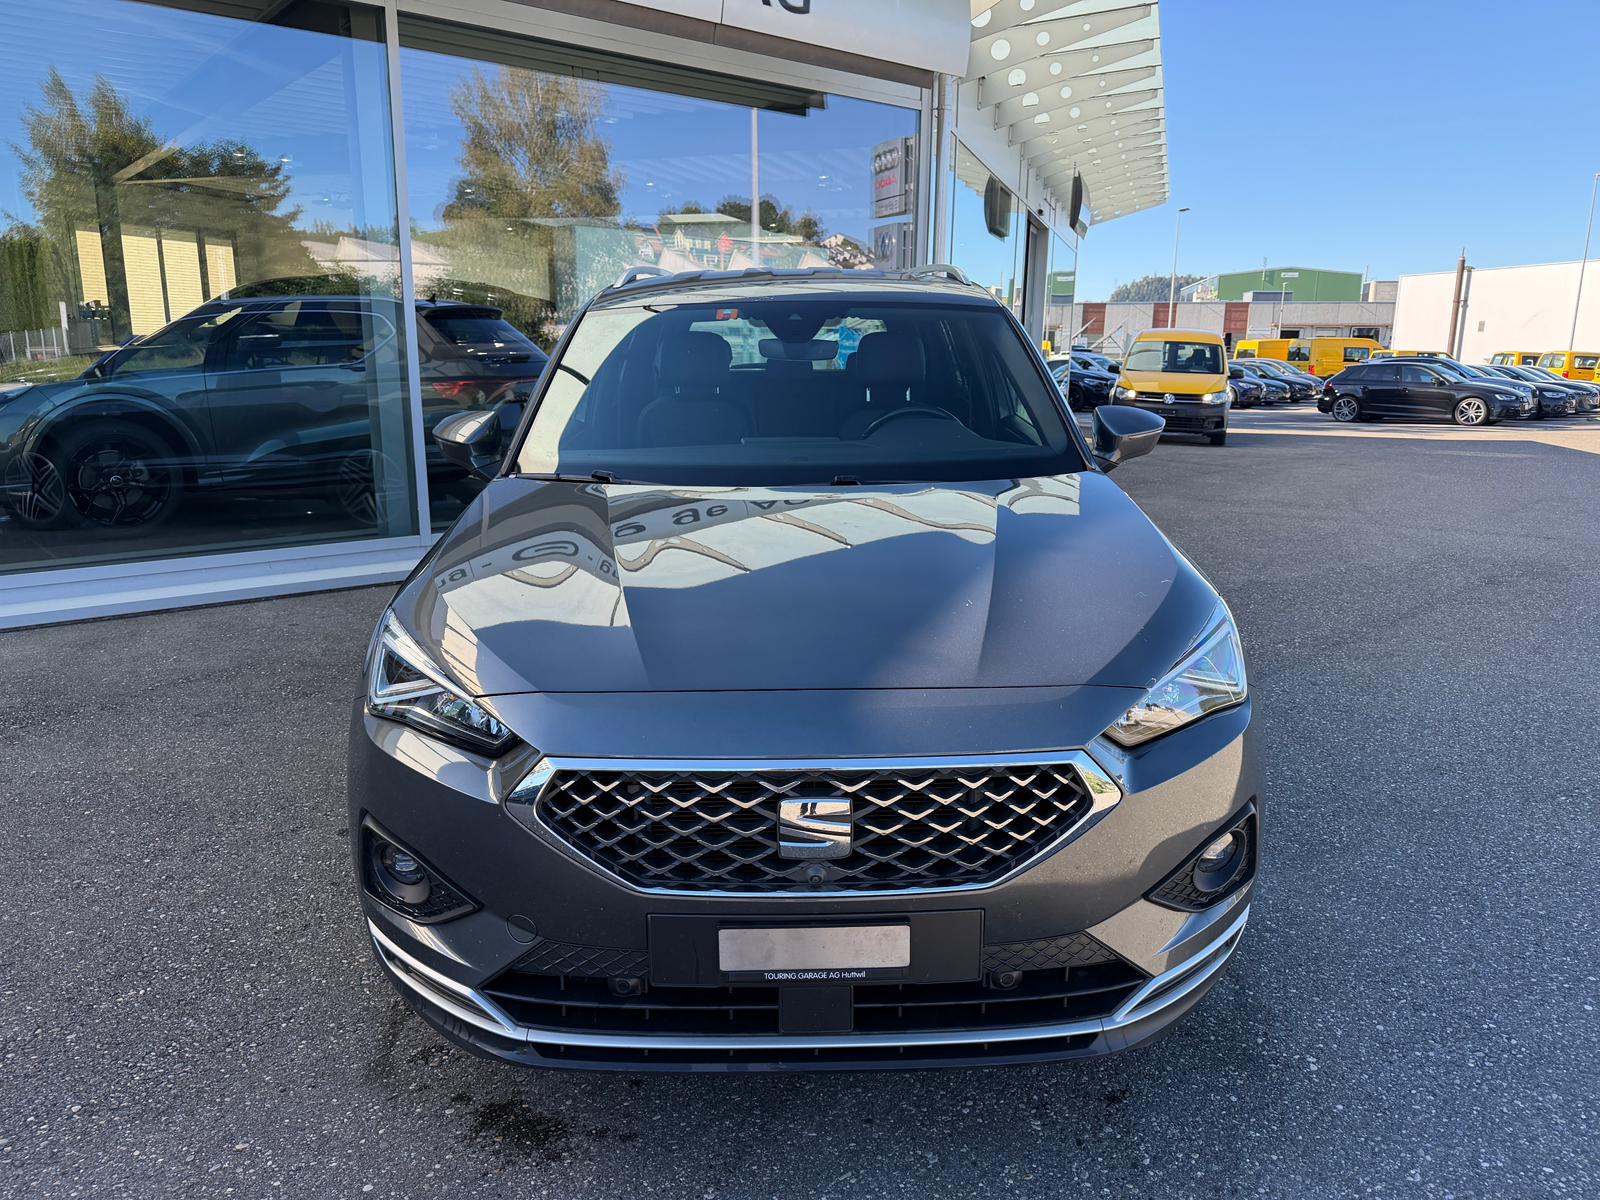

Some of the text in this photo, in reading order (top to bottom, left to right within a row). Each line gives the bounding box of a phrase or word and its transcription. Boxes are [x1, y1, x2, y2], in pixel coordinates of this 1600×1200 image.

[764, 970, 866, 980] TOURING GARAGE AG Huttwil
